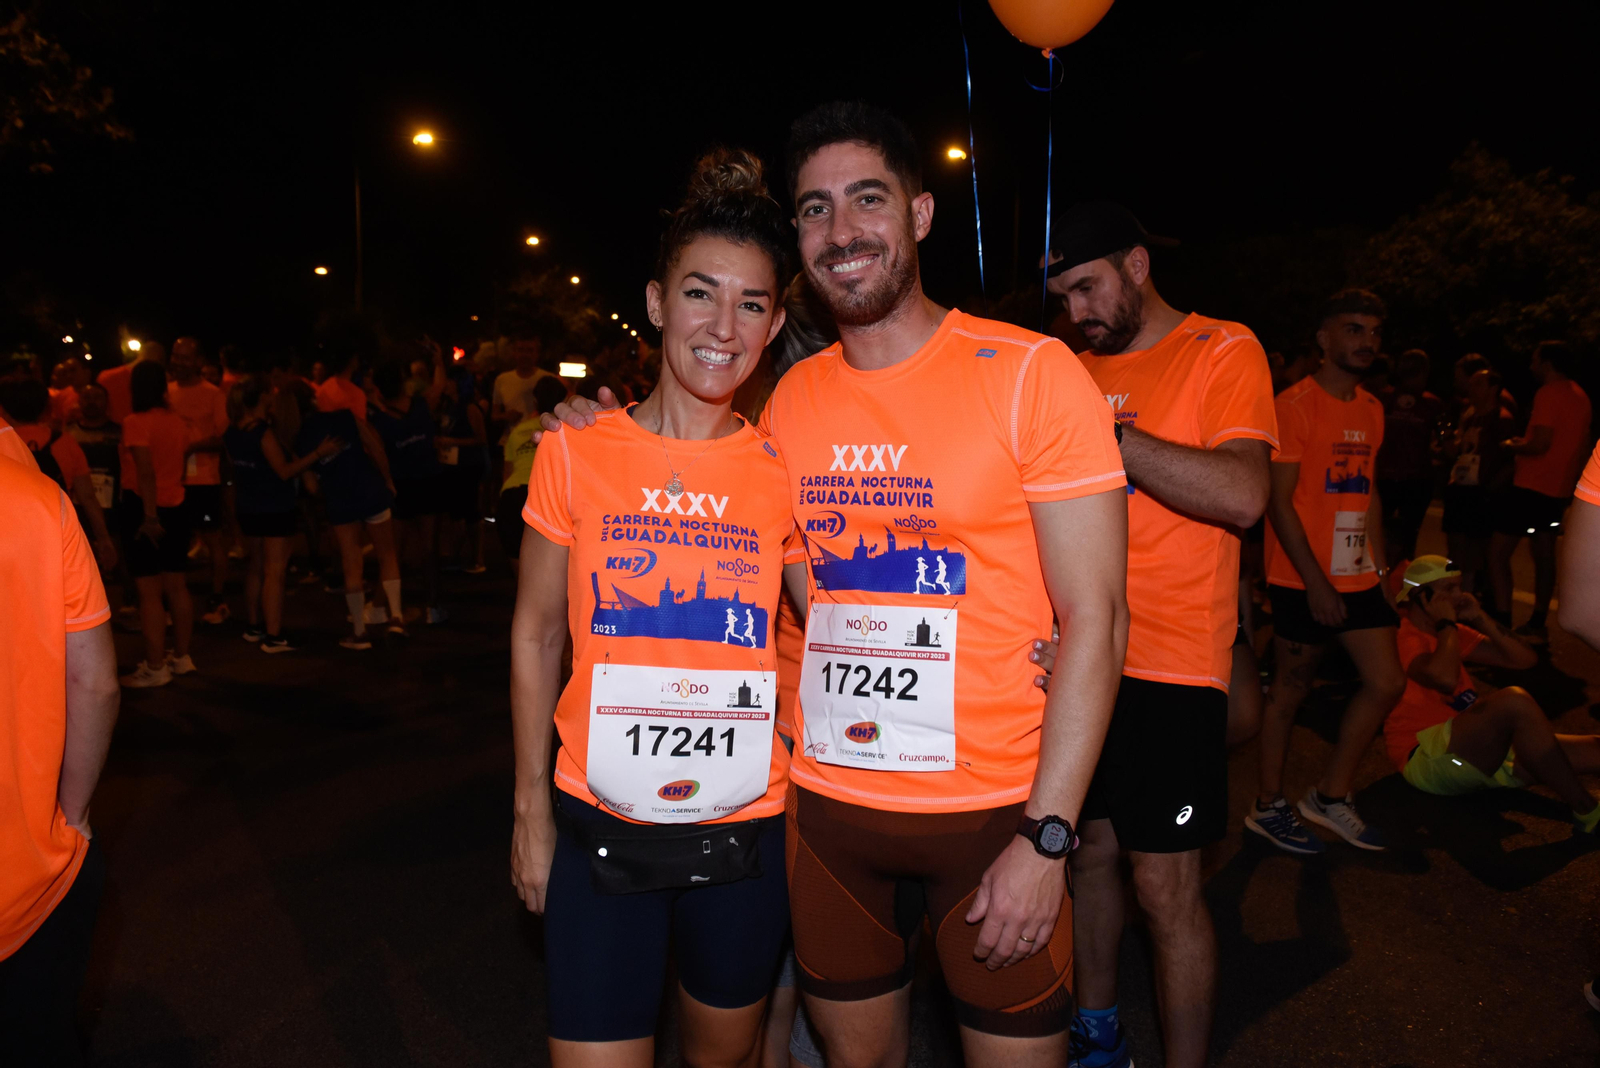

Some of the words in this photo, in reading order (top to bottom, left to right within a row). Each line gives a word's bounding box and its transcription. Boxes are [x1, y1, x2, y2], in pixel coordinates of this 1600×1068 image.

[829, 444, 908, 472] XXXV
[801, 476, 854, 487] CARRERA
[861, 477, 933, 489] NOCTURNA
[640, 488, 729, 518] XXXV
[807, 491, 934, 508] GUADALQUIVIR
[601, 526, 609, 541] DEL
[603, 514, 672, 527] CARRERA
[680, 520, 758, 538] NOCTURNA
[612, 528, 760, 554] GUADALQUIVIR
[1345, 534, 1365, 547] 176
[593, 624, 616, 634] 2023
[872, 650, 916, 658] GUADALQUIVIR
[822, 662, 918, 701] 17242
[626, 724, 734, 756] 17241
[899, 753, 946, 764] Cruzcampo
